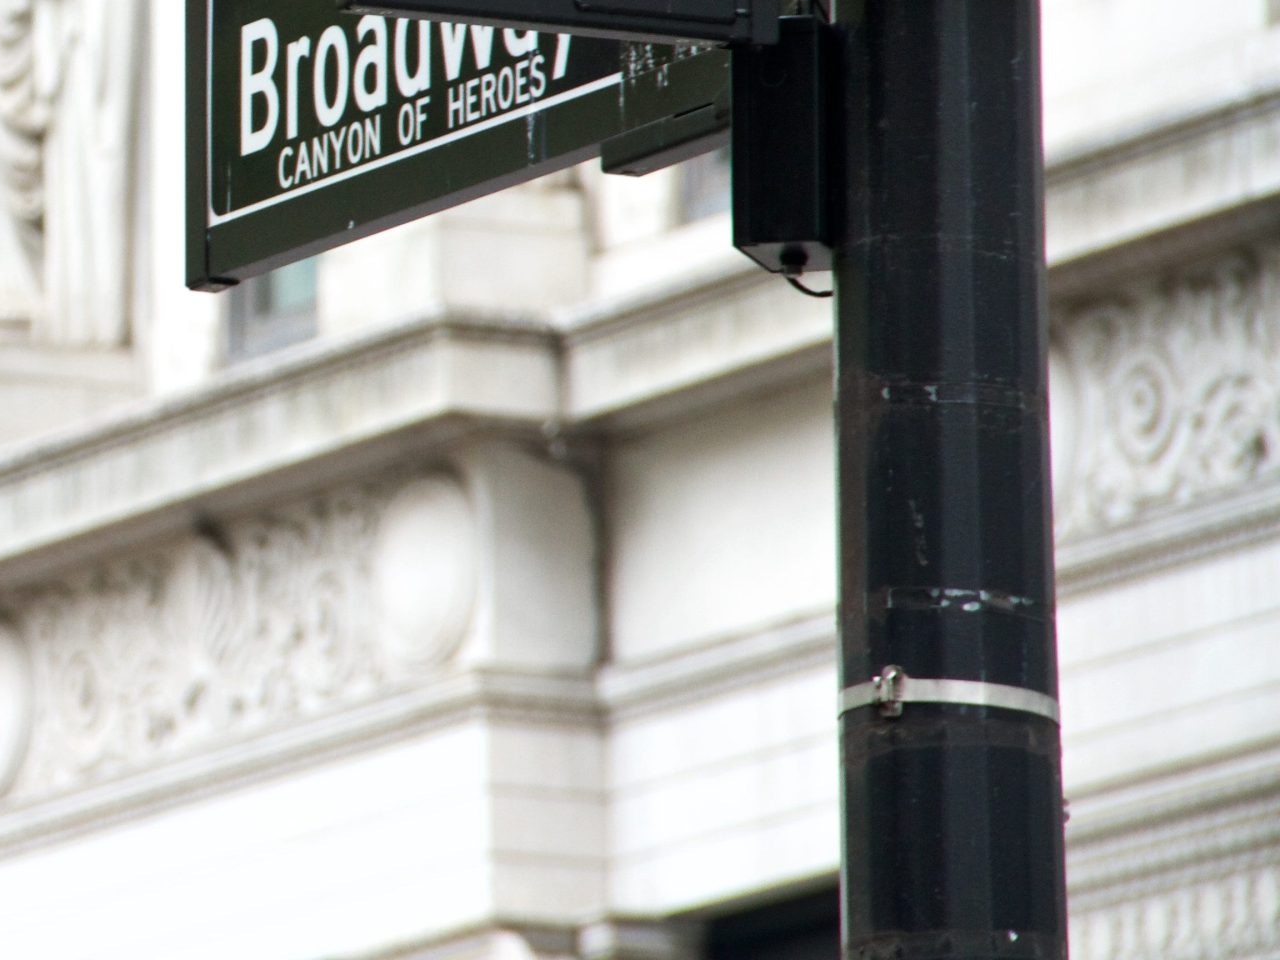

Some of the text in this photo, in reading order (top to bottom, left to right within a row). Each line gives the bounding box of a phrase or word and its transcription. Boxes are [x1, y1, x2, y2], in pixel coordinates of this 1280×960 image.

[277, 54, 546, 189] CANYON OF HEROES
